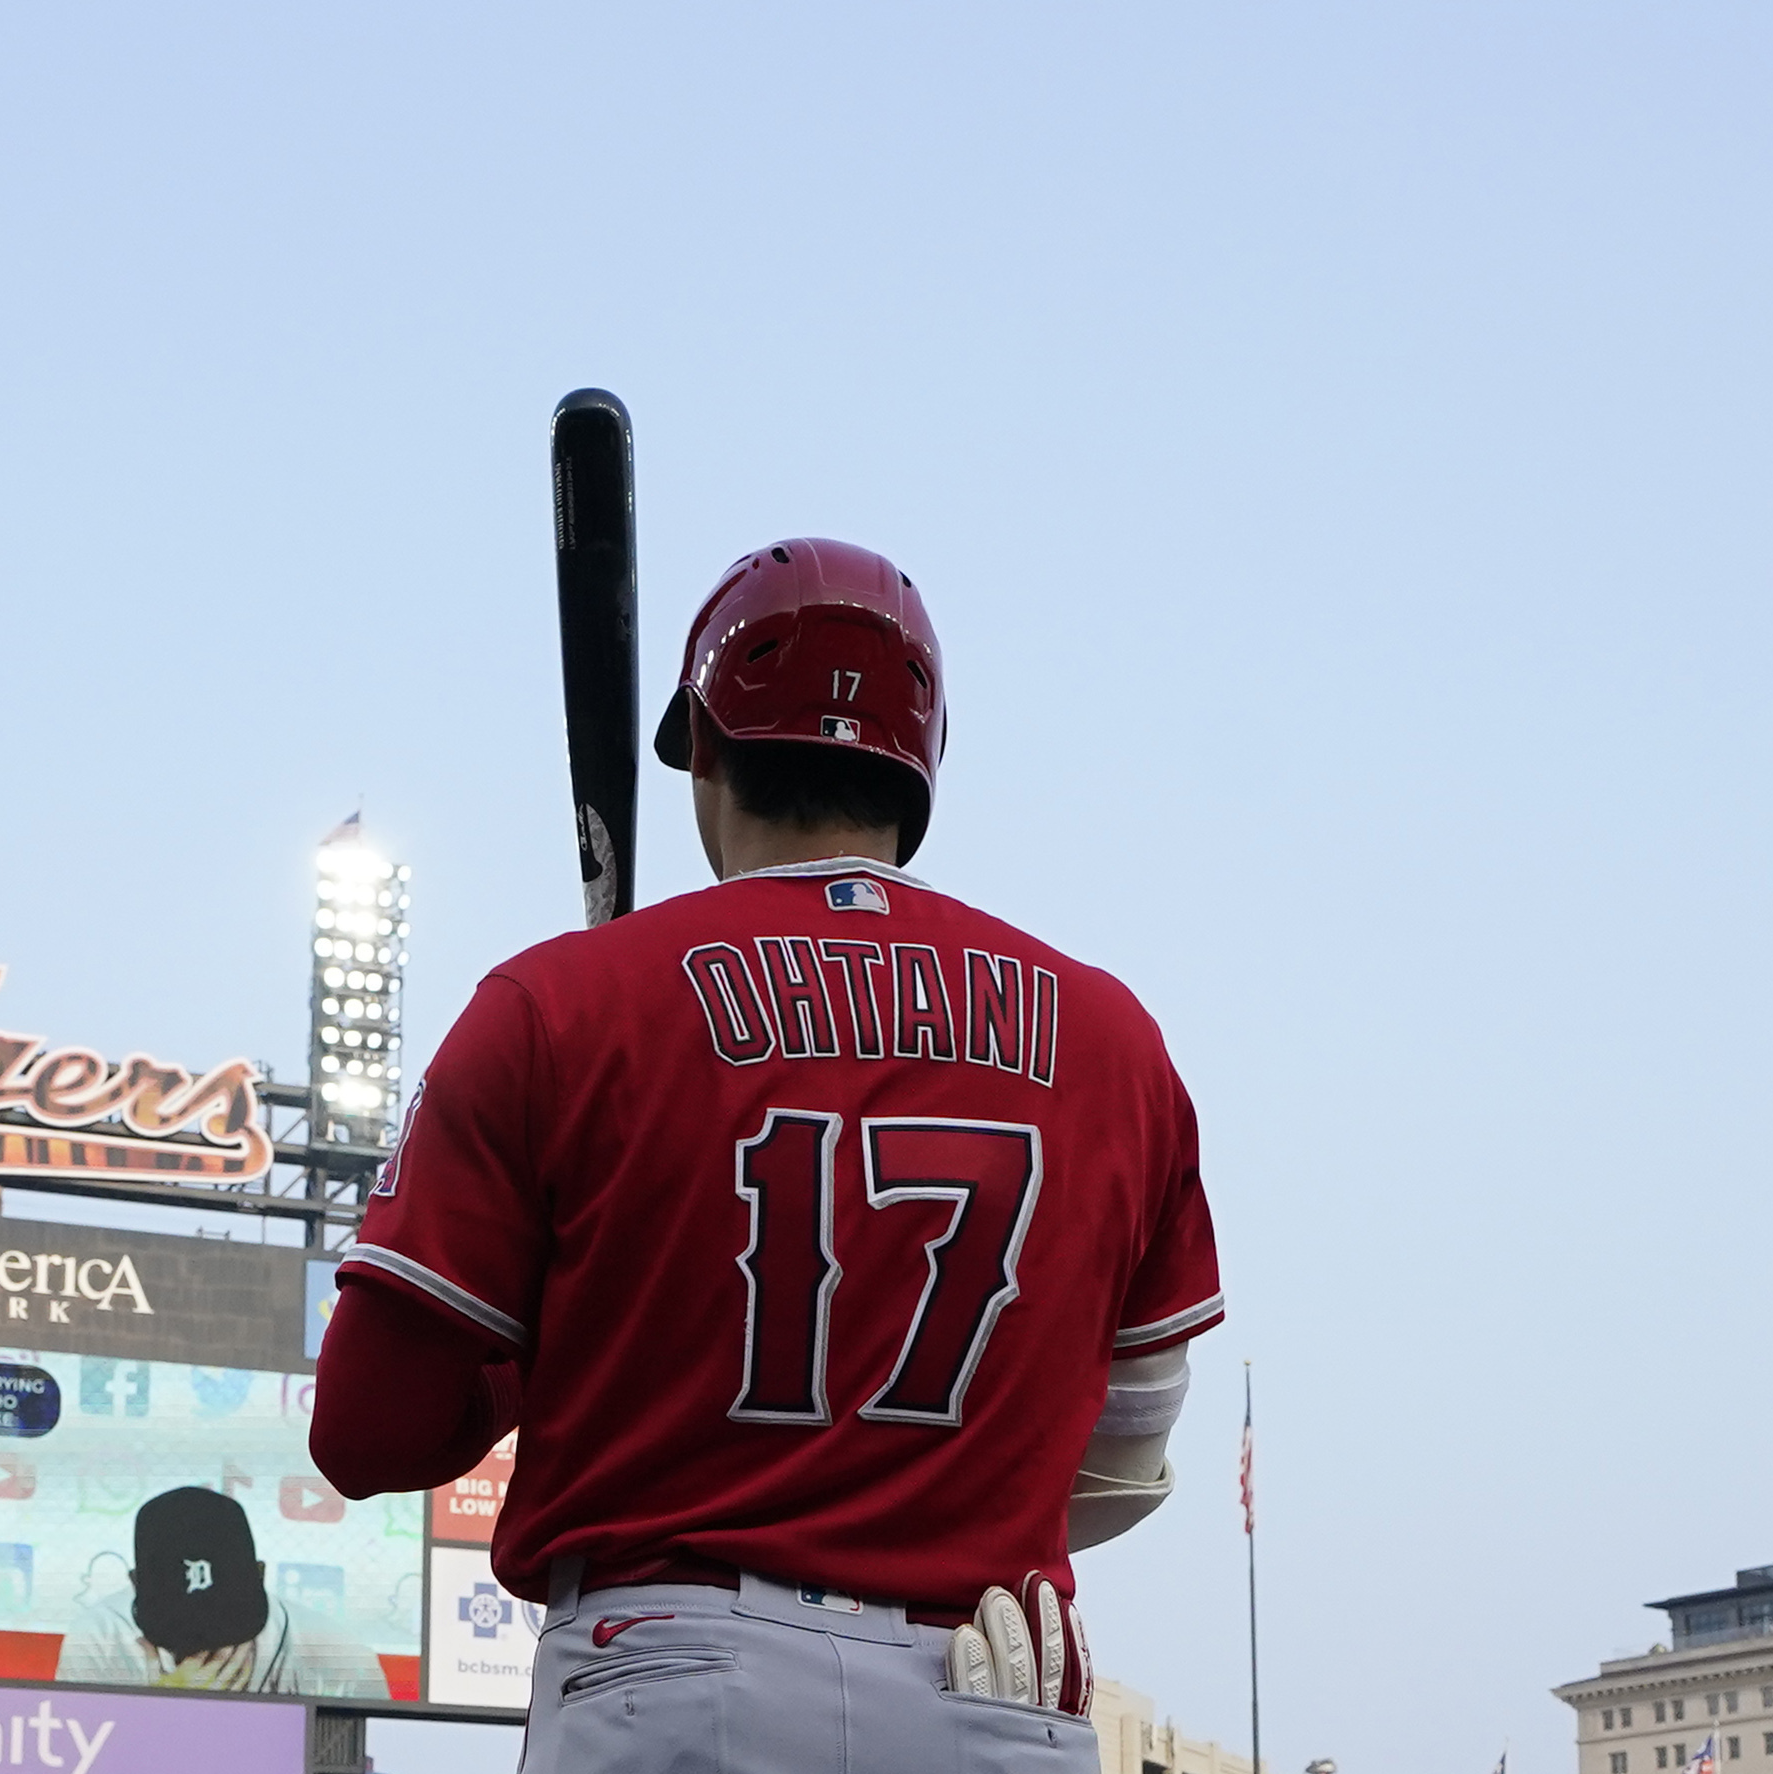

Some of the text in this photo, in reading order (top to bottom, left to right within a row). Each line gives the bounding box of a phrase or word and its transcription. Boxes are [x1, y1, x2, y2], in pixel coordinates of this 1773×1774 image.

[832, 669, 862, 702] 17
[682, 936, 1060, 1088] OHTANI
[727, 1108, 1044, 1427] 17
[455, 1478, 493, 1497] BIG
[449, 1498, 496, 1517] LOW
